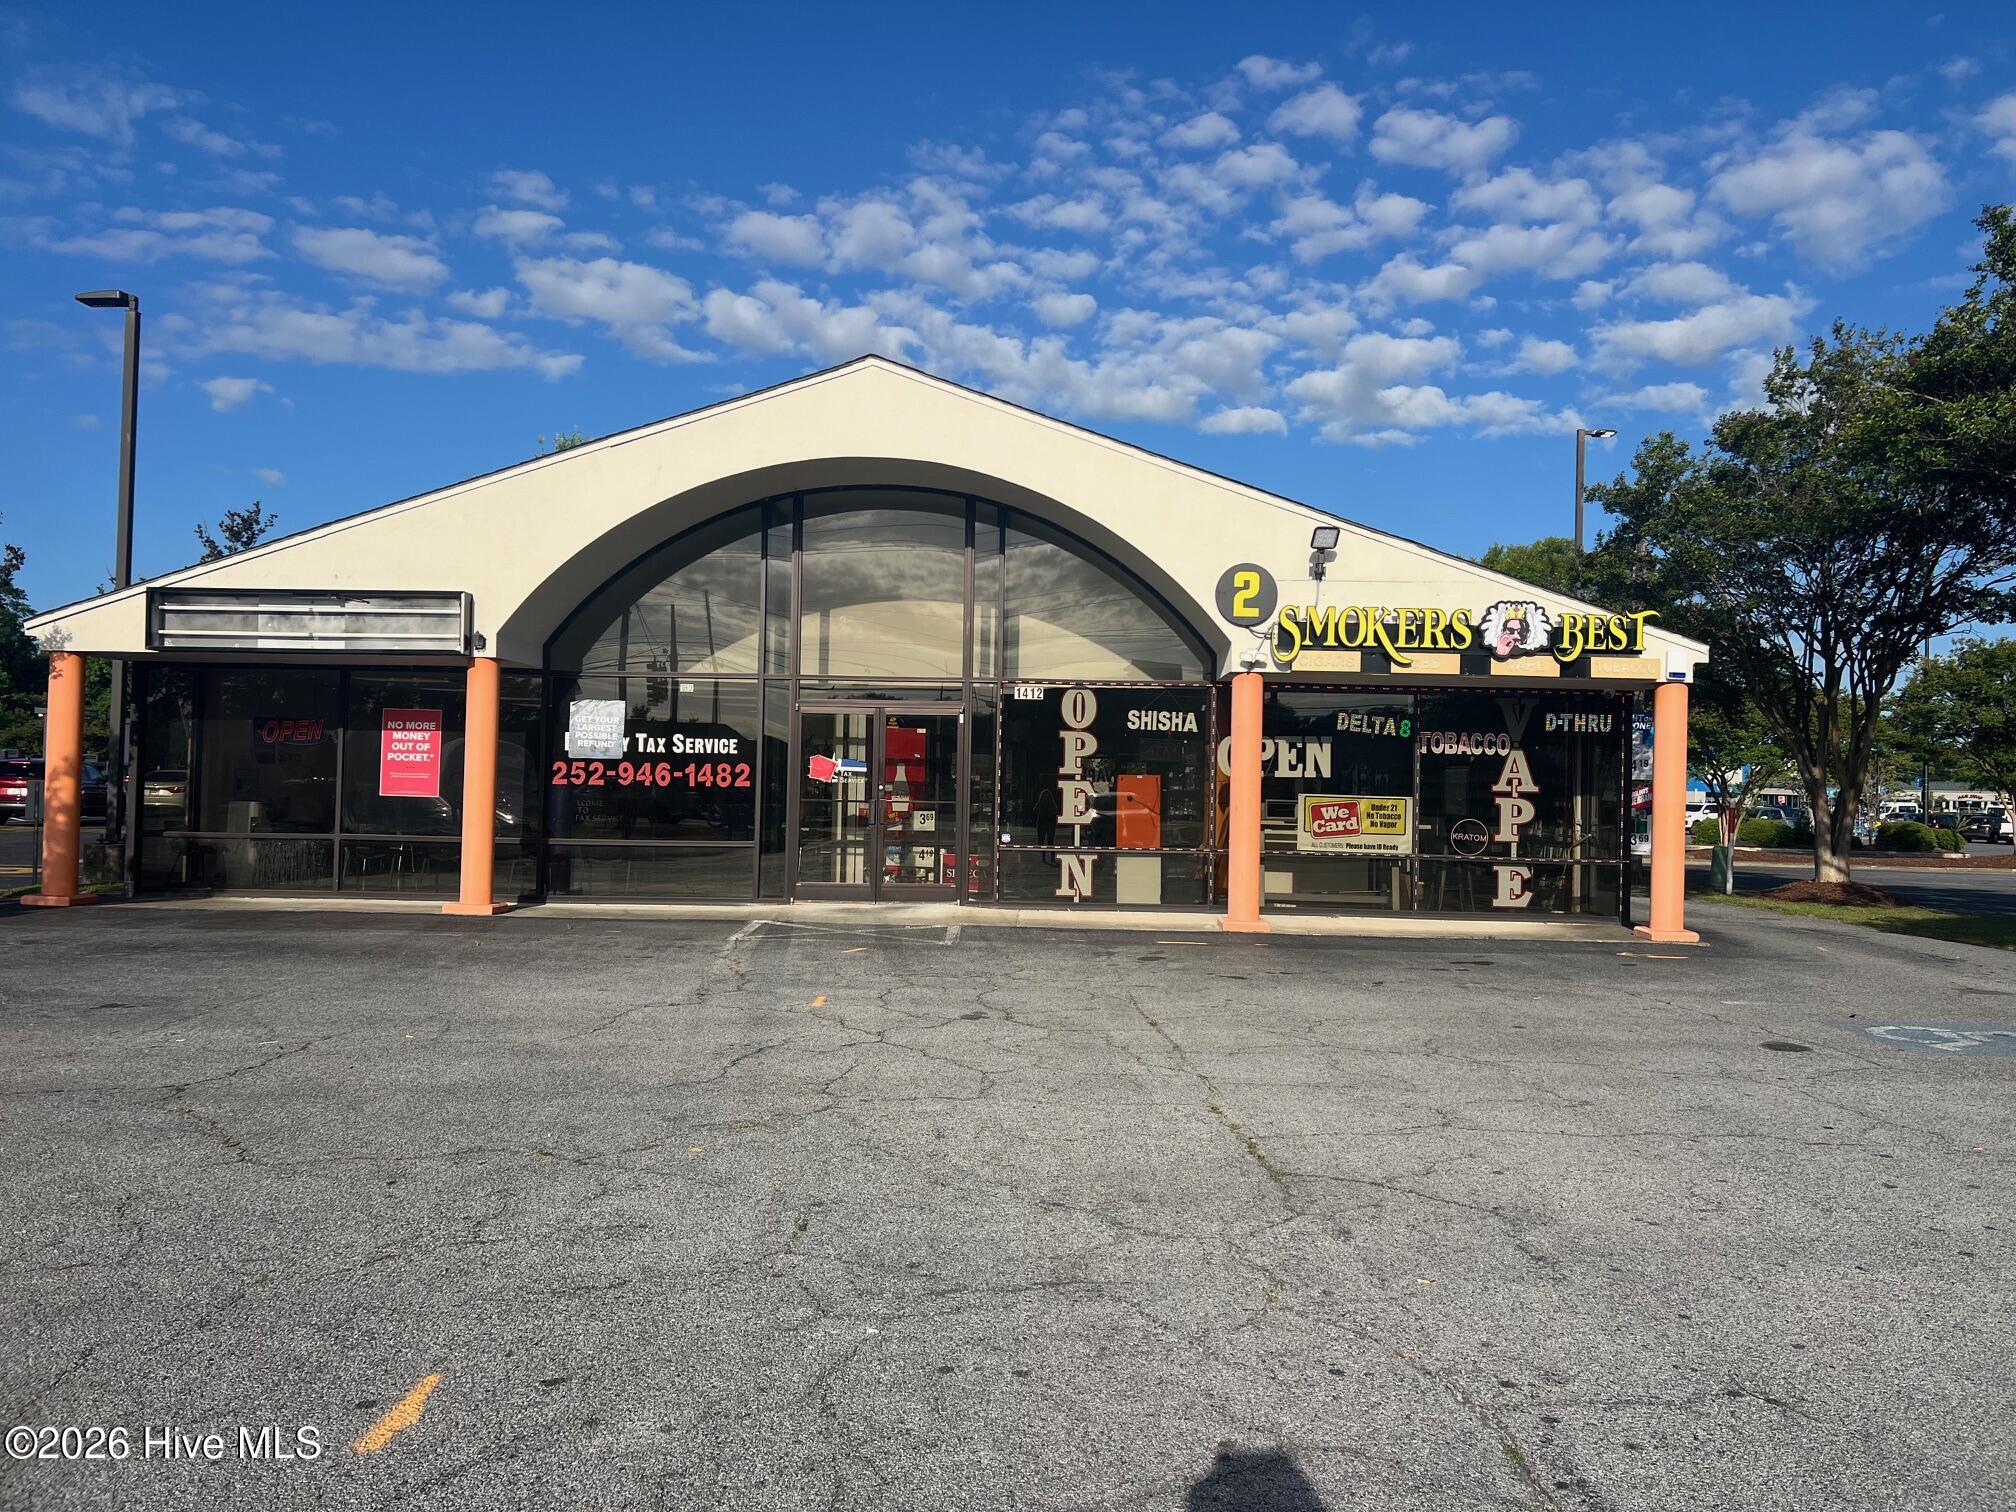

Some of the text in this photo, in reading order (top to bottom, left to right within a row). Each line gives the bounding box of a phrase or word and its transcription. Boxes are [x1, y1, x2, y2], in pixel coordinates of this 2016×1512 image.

[1233, 571, 1260, 617] 2
[1271, 604, 1661, 665] SMOKERS BEST
[1015, 686, 1043, 700] 1412
[387, 720, 437, 731] NO MORE
[575, 715, 620, 724] GET YOUR
[1126, 709, 1199, 733] SHISHA
[1336, 711, 1412, 738] DELTA 8
[1545, 712, 1612, 733] D-THRU
[262, 719, 325, 744] OPEN
[576, 723, 617, 732] LARGEST
[392, 731, 431, 741] MONEY
[574, 731, 619, 741] POSSIBLE
[635, 732, 666, 754] TAX
[672, 733, 738, 755] SERVICE
[1418, 730, 1511, 757] TOBACCO
[391, 742, 431, 752] OUT OF
[551, 761, 751, 788] 252-946-1482
[1055, 685, 1098, 898] OPEN
[1370, 803, 1390, 812] Under
[1491, 697, 1541, 909] VAPE
[1320, 805, 1350, 820] We
[1366, 812, 1402, 820] No Tobacco
[1312, 816, 1359, 834] Card
[1370, 820, 1398, 829] No Vapor
[1452, 832, 1488, 842] KRATOM
[1346, 842, 1363, 850] Please
